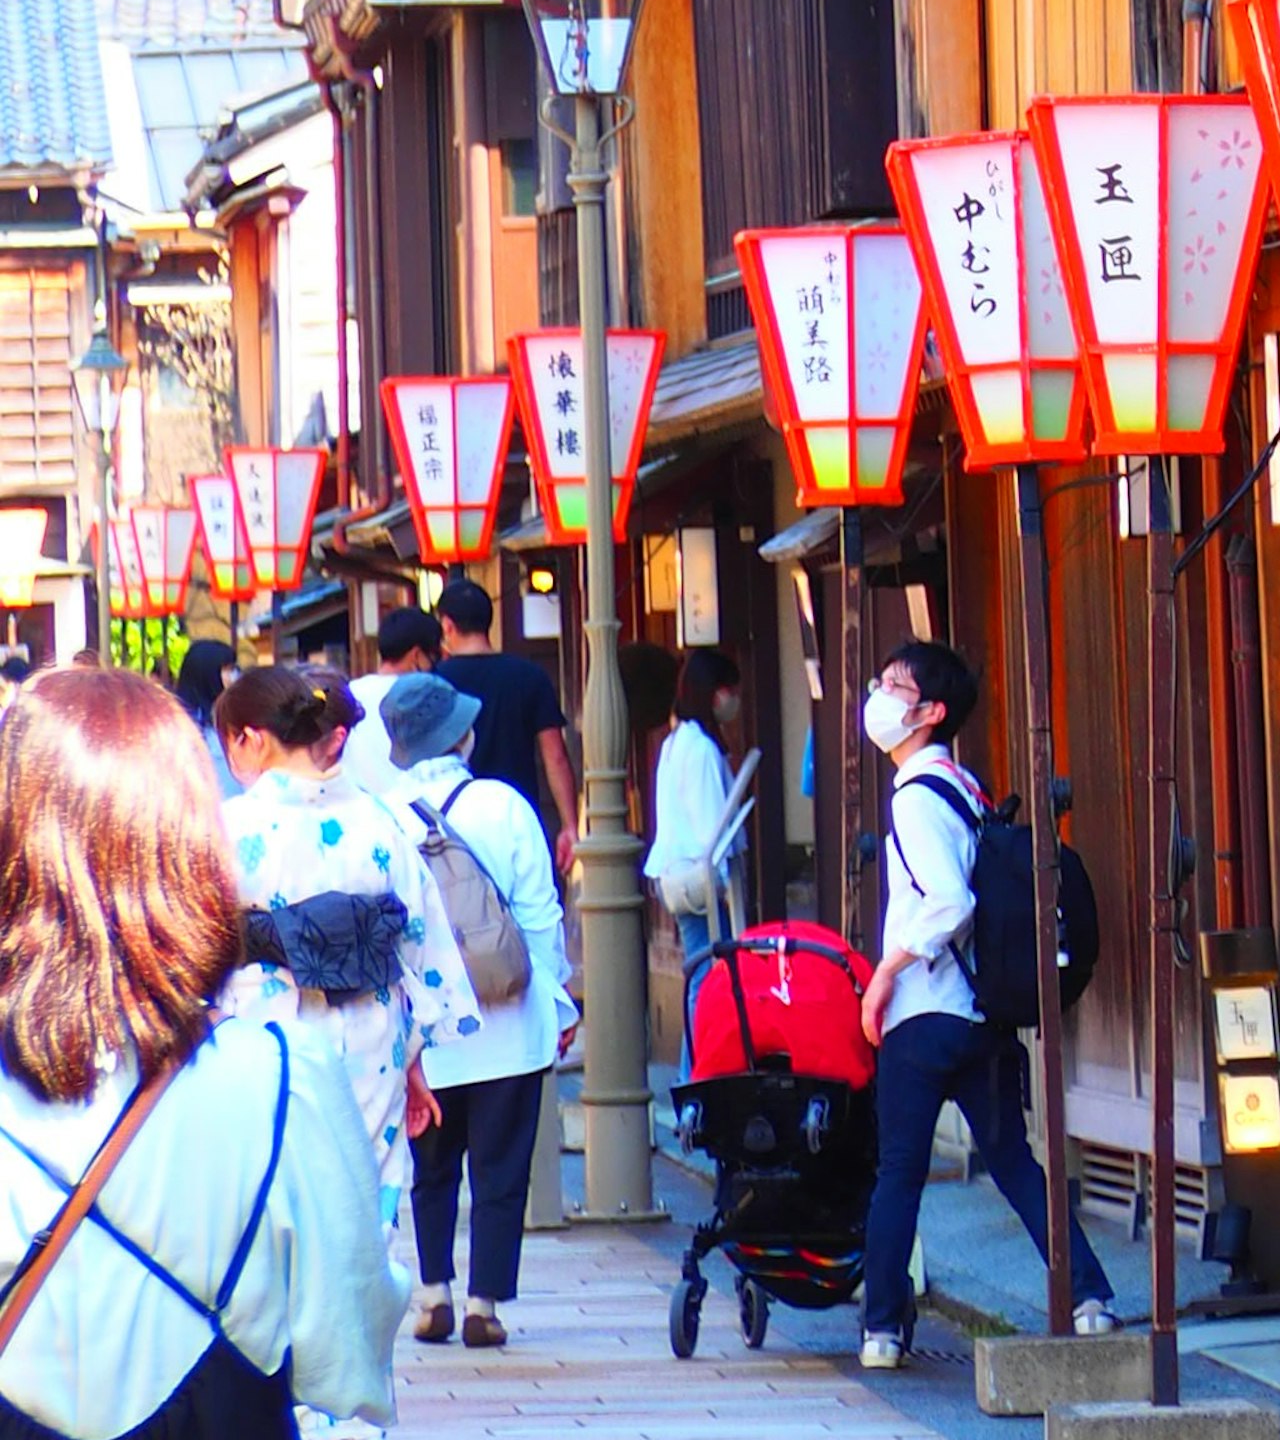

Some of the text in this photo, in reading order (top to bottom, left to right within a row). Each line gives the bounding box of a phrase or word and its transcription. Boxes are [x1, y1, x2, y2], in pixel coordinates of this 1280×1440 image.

[985, 159, 1004, 222] ひがし
[1094, 163, 1142, 283] 玉匣
[952, 192, 997, 318] 中むら
